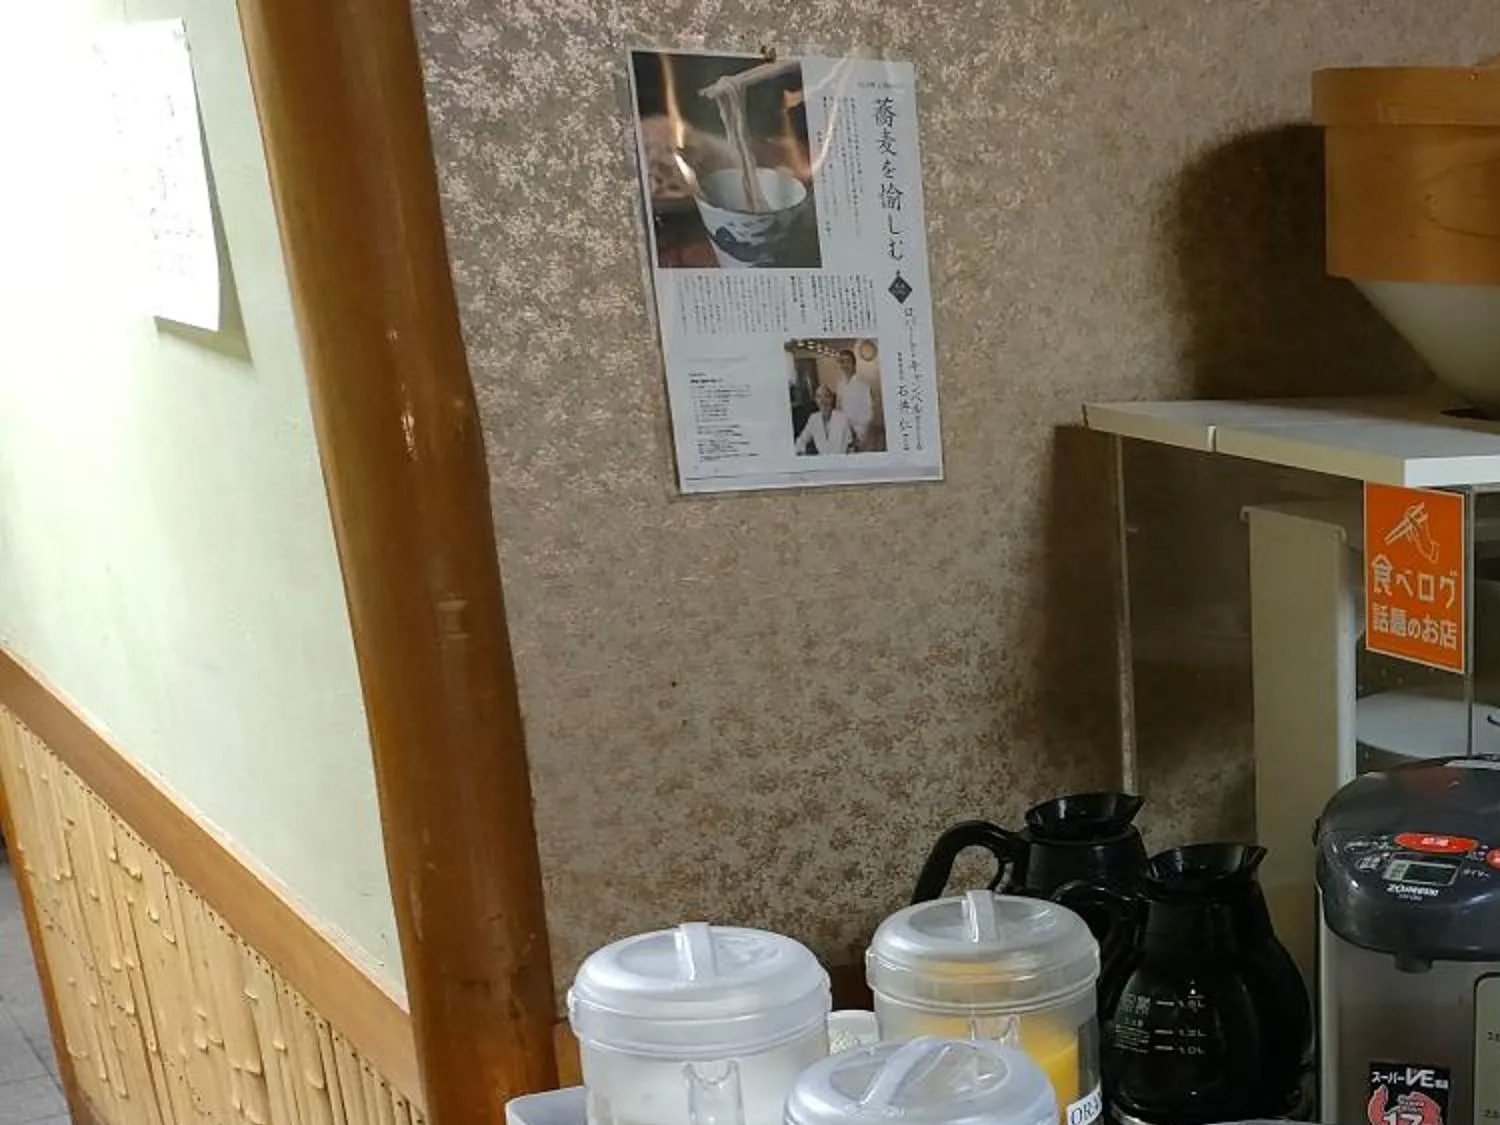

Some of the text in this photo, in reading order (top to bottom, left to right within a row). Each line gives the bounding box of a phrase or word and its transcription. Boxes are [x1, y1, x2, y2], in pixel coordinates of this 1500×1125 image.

[1371, 553, 1458, 609] 食べログ
[1373, 603, 1457, 650] 話題のお店
